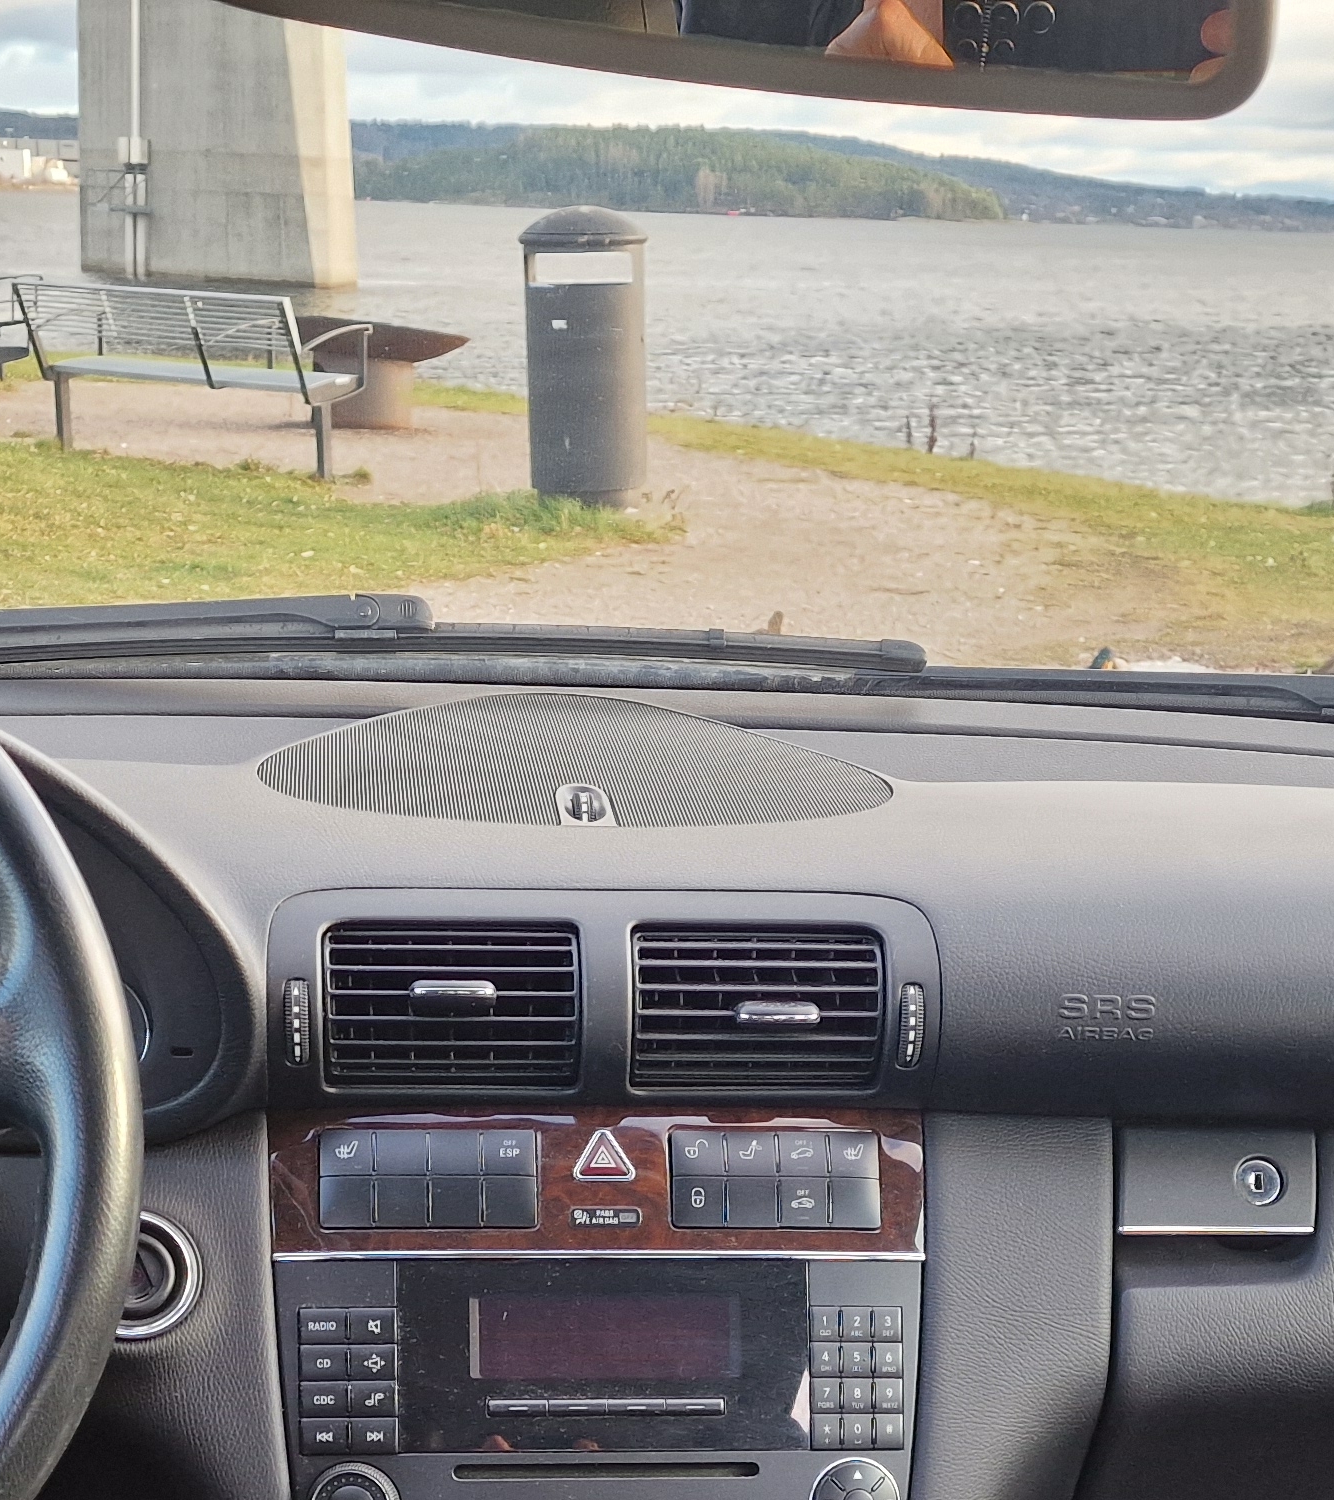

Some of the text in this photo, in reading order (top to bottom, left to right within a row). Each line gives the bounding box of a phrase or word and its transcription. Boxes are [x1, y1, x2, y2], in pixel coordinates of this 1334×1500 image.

[1058, 993, 1156, 1020] SRS
[1058, 1026, 1154, 1041] AIRBAG
[499, 1148, 521, 1158] ESP
[308, 1322, 336, 1331] RADIO
[316, 1359, 331, 1368] CD
